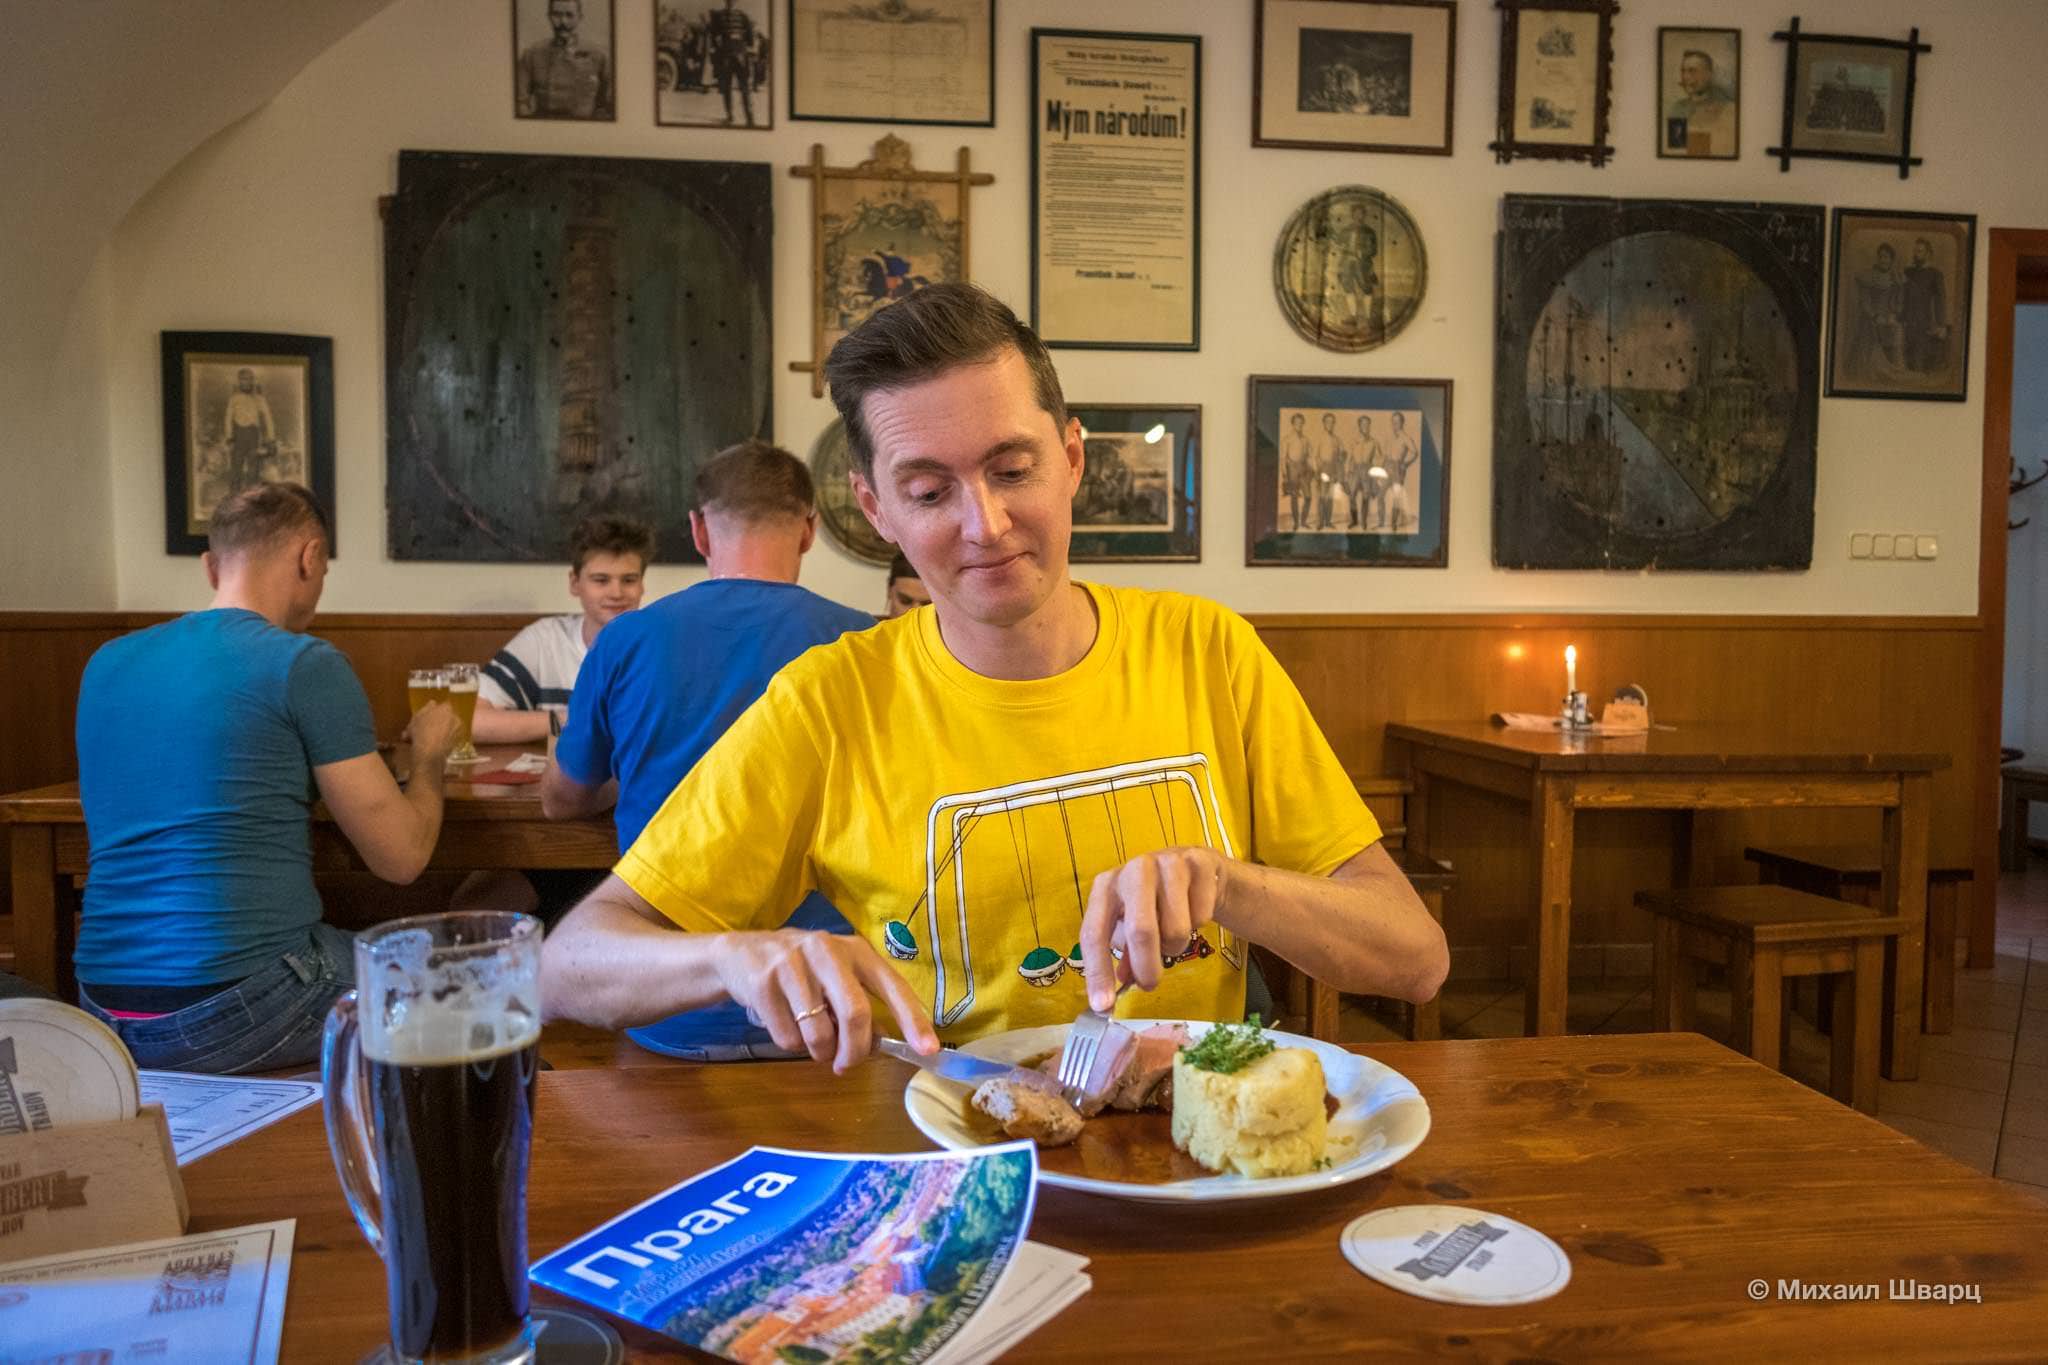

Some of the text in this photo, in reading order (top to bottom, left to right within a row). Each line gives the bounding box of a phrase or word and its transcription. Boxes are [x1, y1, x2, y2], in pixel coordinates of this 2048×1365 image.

[1046, 99, 1187, 141] Mým národům!
[564, 1171, 798, 1290] Прага
